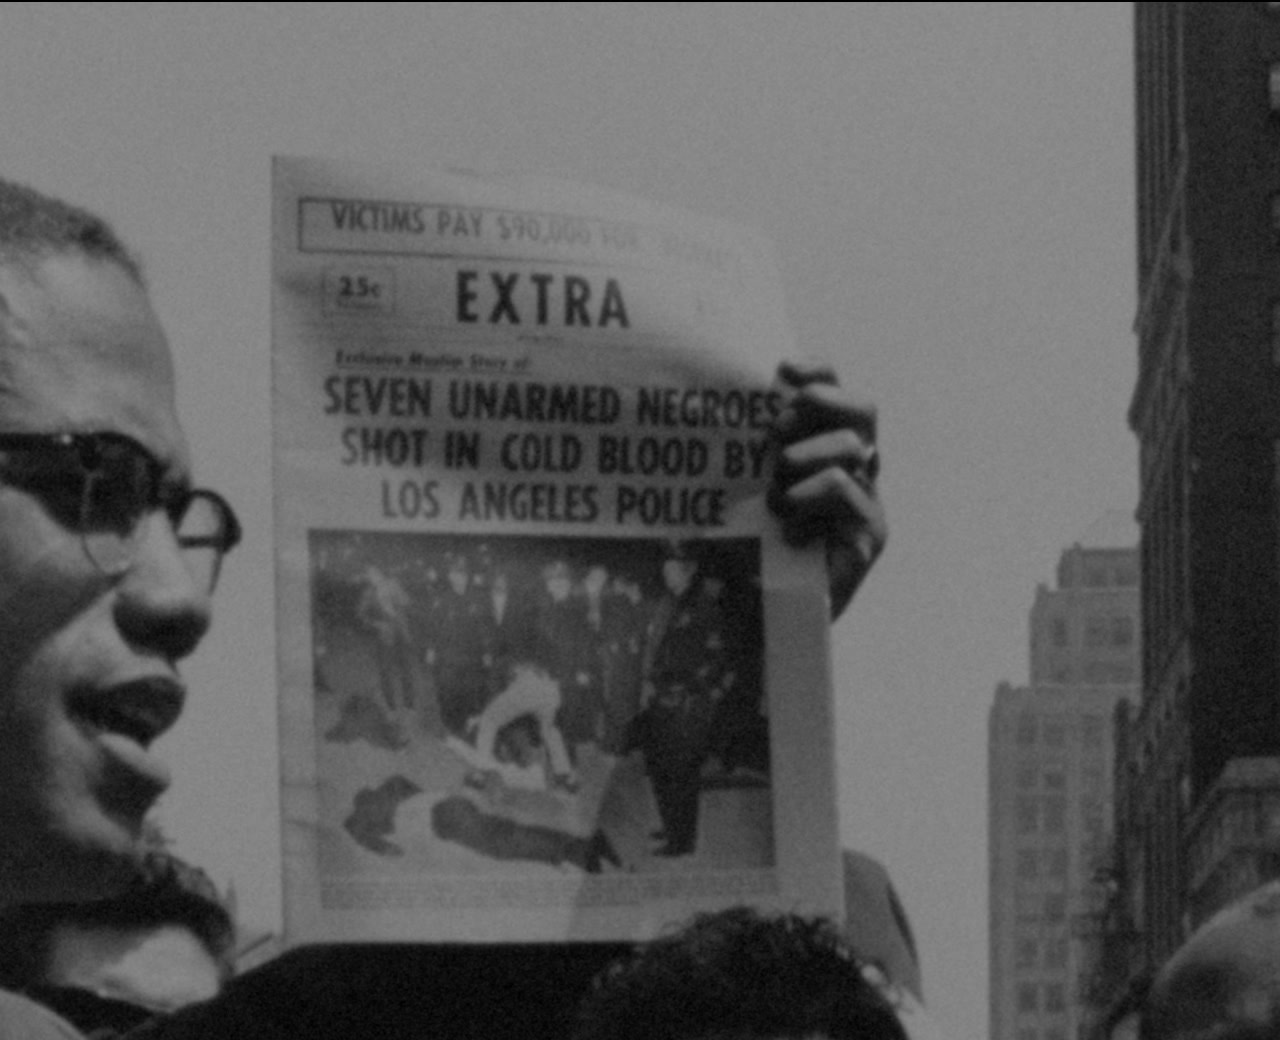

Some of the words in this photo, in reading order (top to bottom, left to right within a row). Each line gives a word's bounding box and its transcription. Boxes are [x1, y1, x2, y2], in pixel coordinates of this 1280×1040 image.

[331, 200, 425, 234] VICTIMS
[437, 209, 483, 237] PAY
[456, 270, 631, 329] EXTRA
[323, 376, 432, 417] SEVEN
[448, 380, 621, 424] UNARMED
[637, 387, 782, 428] NEGROES
[340, 427, 428, 467] SHOT
[443, 431, 480, 469] IN
[500, 433, 582, 473] COLD
[597, 435, 709, 476] BLOOD
[723, 439, 772, 479] BY
[381, 480, 440, 519] LOS
[458, 481, 599, 522] ANGELES
[616, 486, 727, 527] POLICE
